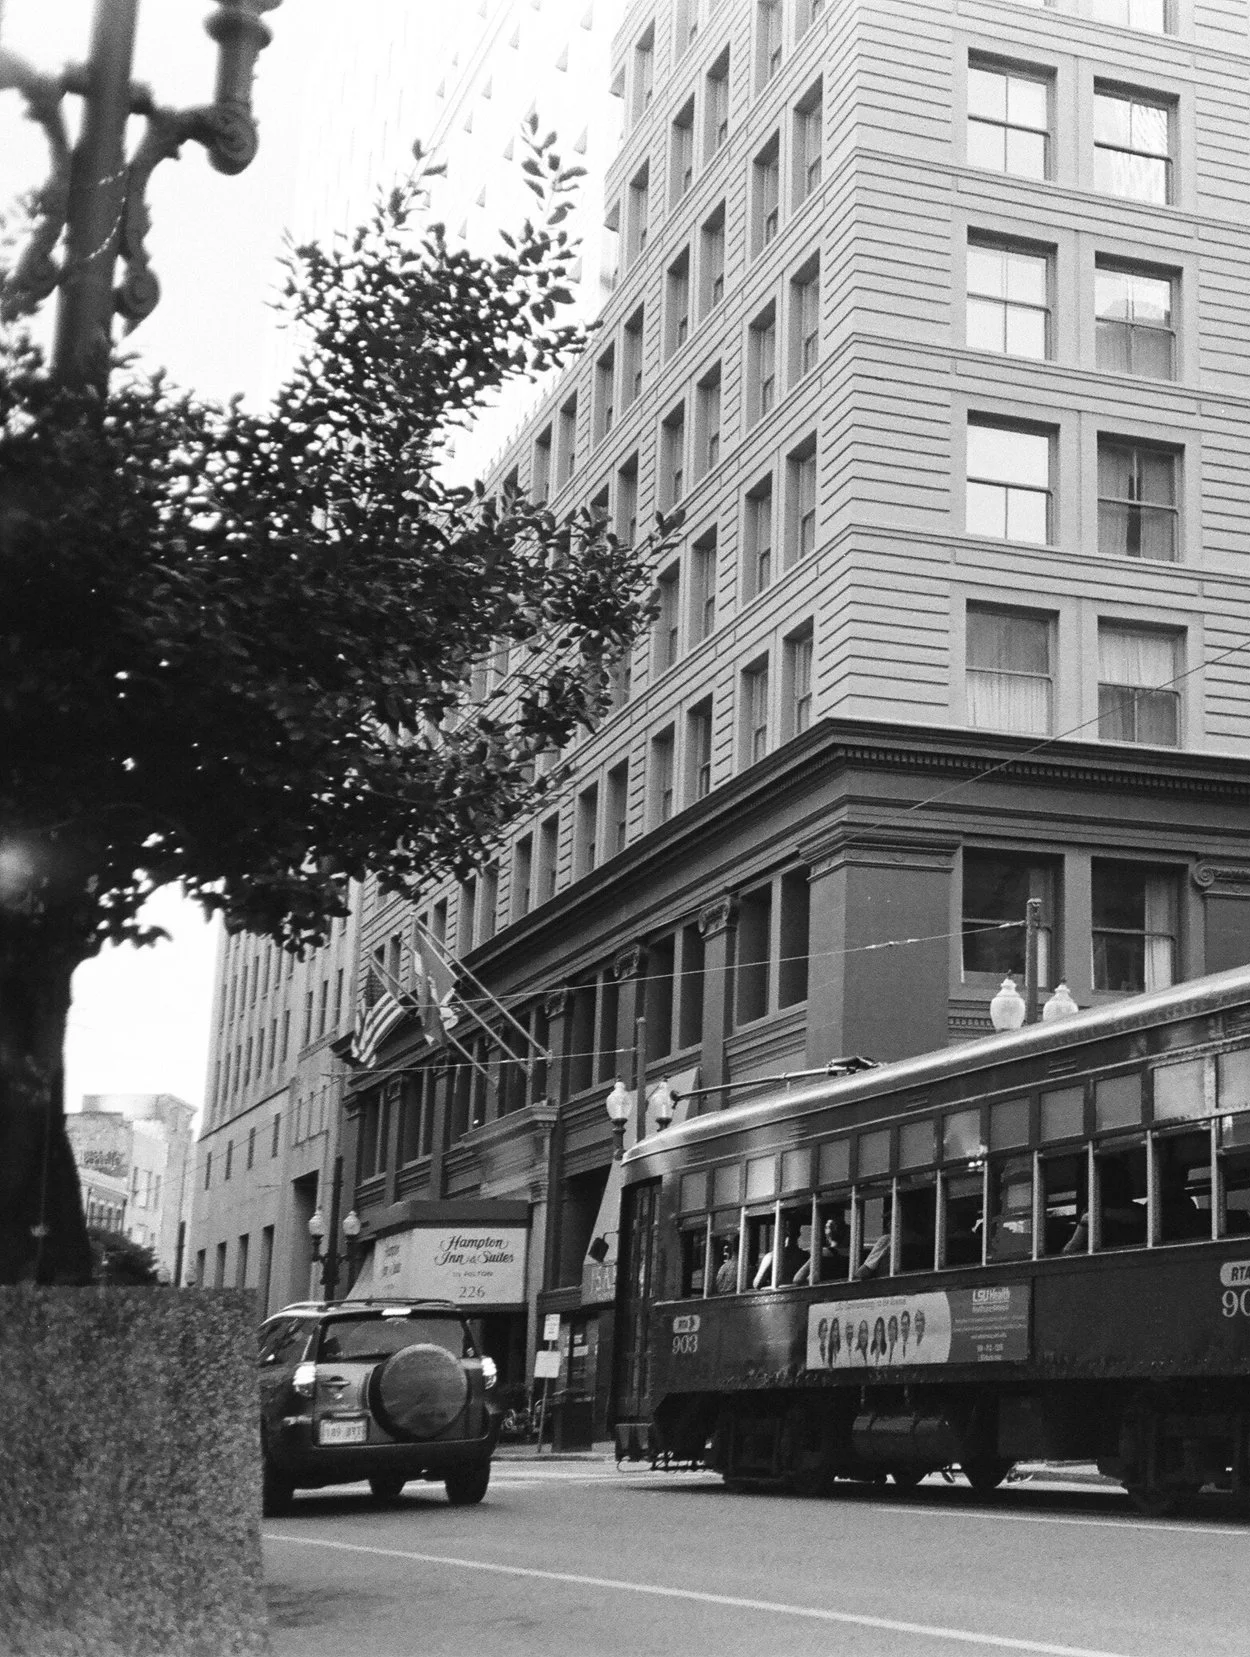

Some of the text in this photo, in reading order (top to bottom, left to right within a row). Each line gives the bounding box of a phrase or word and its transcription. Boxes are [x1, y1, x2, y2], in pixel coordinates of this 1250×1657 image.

[440, 1235, 509, 1252] Hampton
[434, 1251, 468, 1266] Inn
[481, 1250, 514, 1264] Suites
[459, 1286, 486, 1298] 226
[671, 1334, 698, 1354] 903
